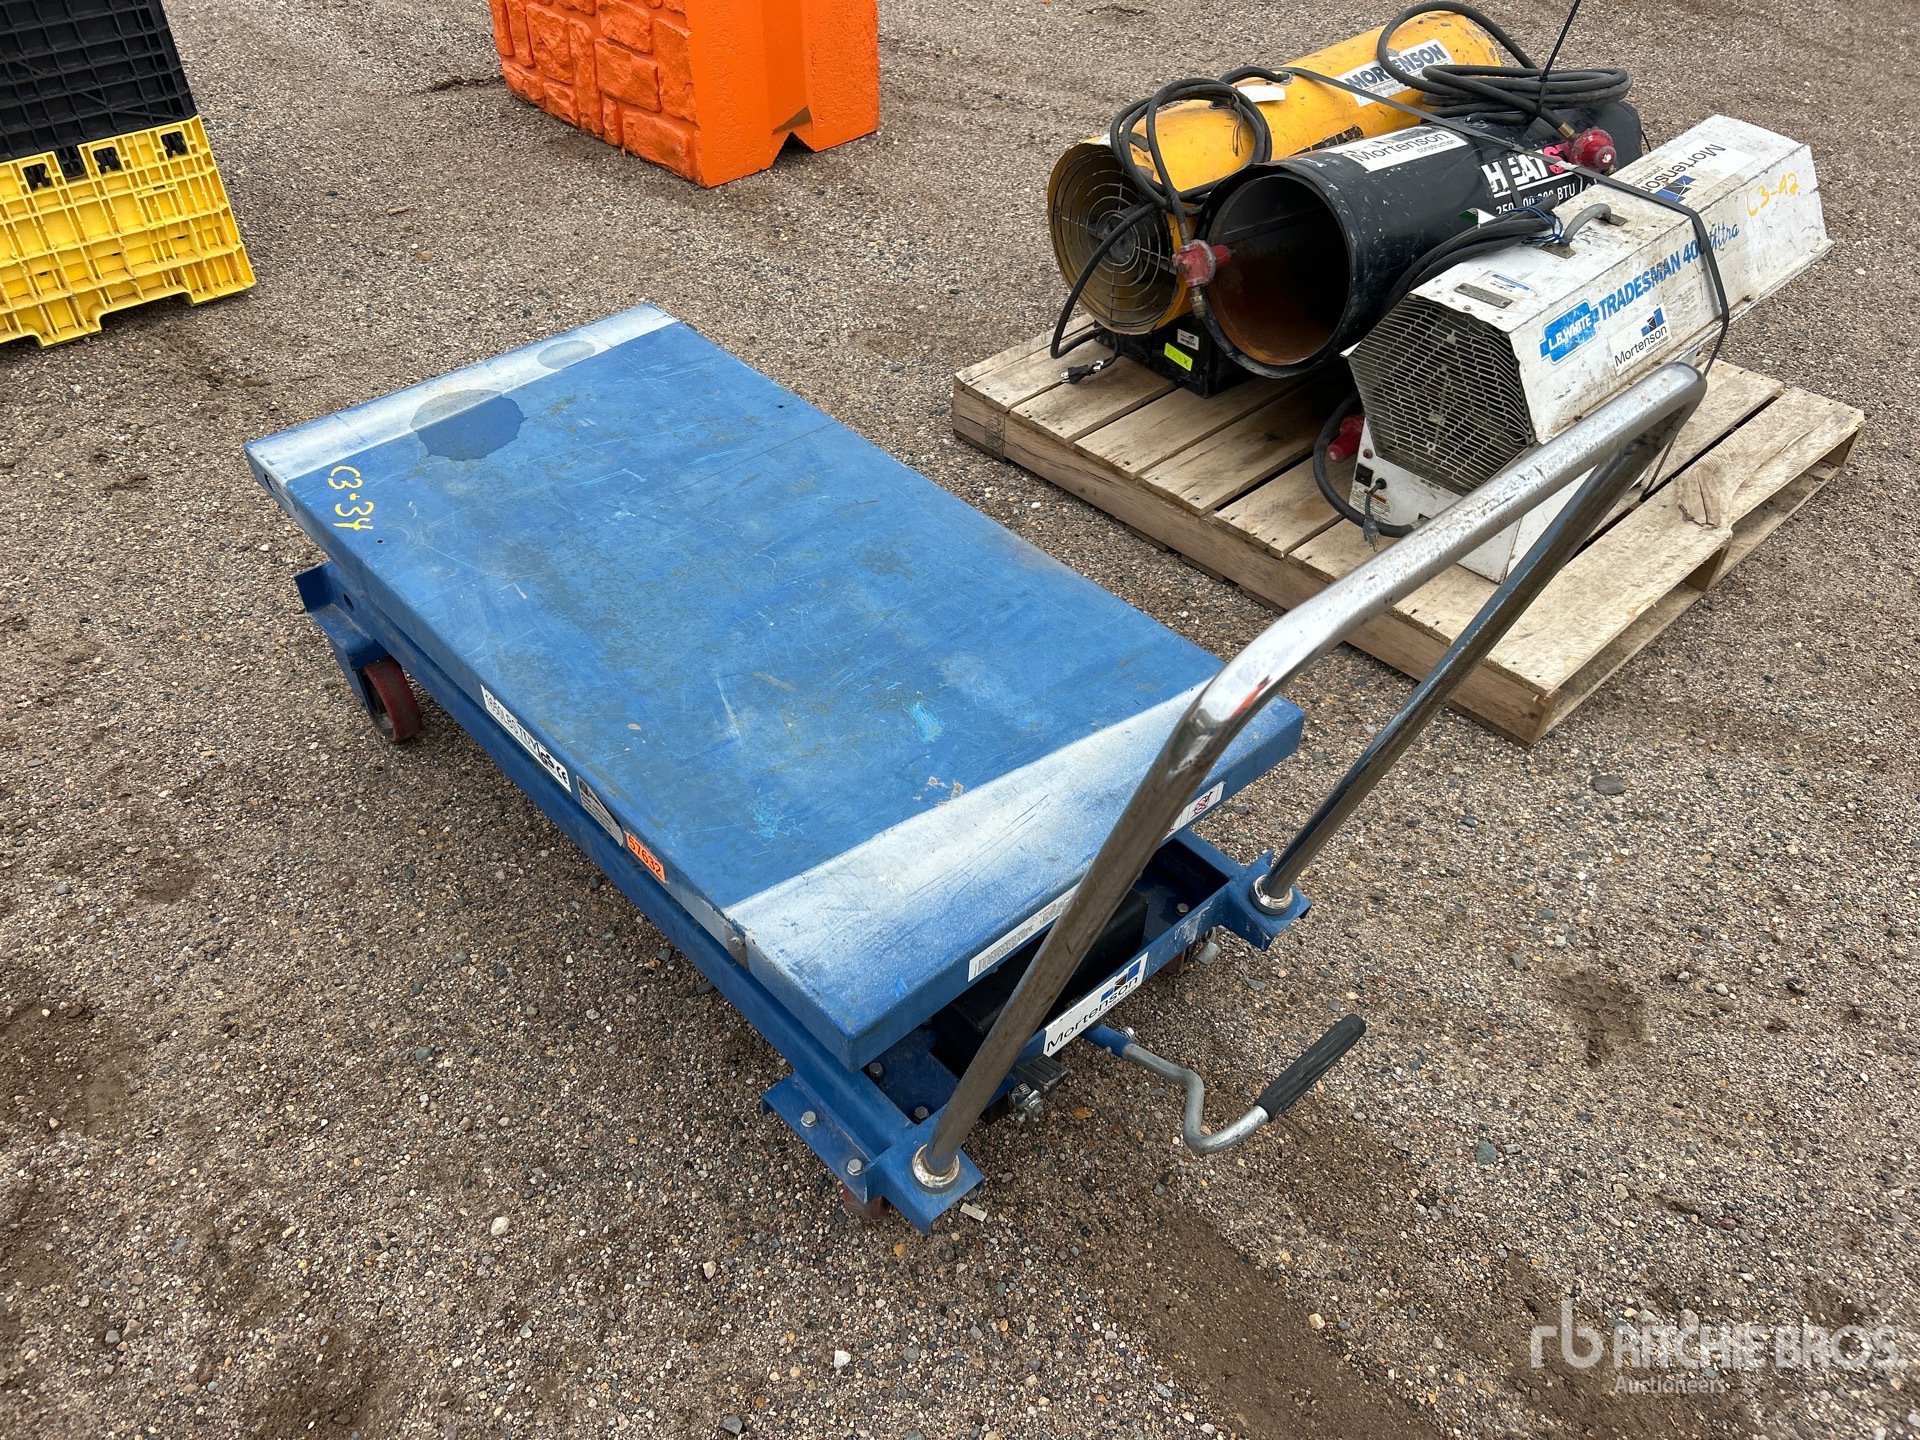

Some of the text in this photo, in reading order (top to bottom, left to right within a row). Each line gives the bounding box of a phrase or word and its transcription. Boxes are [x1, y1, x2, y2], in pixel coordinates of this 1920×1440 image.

[1345, 44, 1447, 89] MORENSON
[1350, 131, 1450, 162] Mortenson
[1556, 182, 1576, 200] BTU
[1598, 250, 1682, 322] TRADESMAN
[1683, 239, 1702, 263] 40
[1614, 325, 1668, 367] Mortenson
[628, 835, 663, 880] 57632
[1046, 976, 1138, 1053] Mortenson
